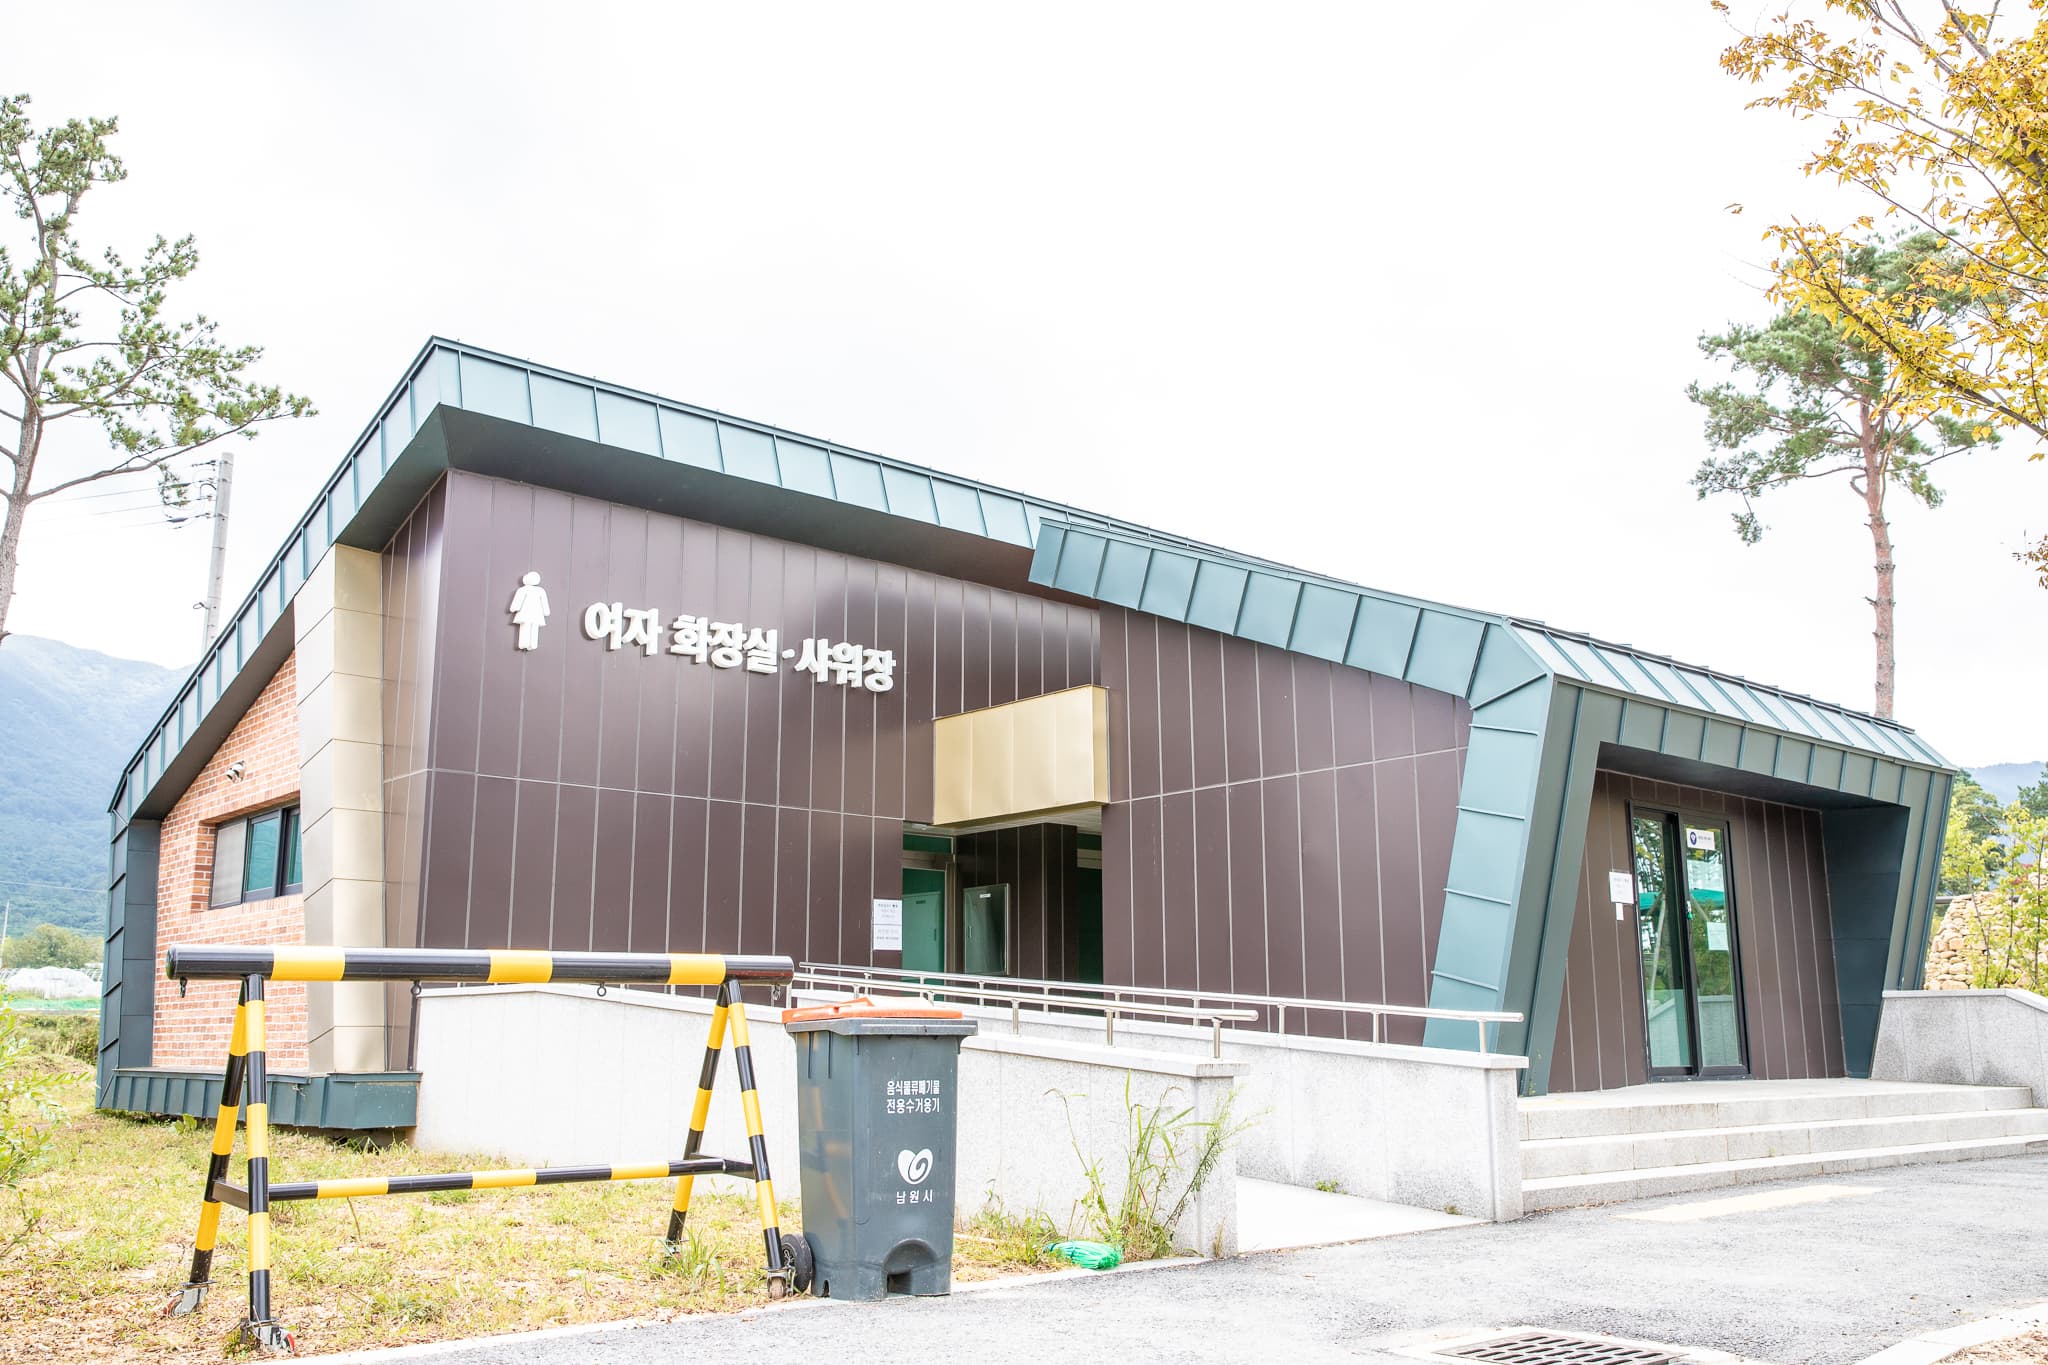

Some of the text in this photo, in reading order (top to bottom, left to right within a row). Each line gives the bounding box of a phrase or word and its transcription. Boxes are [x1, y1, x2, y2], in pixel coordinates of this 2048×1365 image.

[584, 601, 663, 656] 여자
[886, 1079, 940, 1096] 음식물류폐기물
[886, 1097, 940, 1114] 전용수거용기
